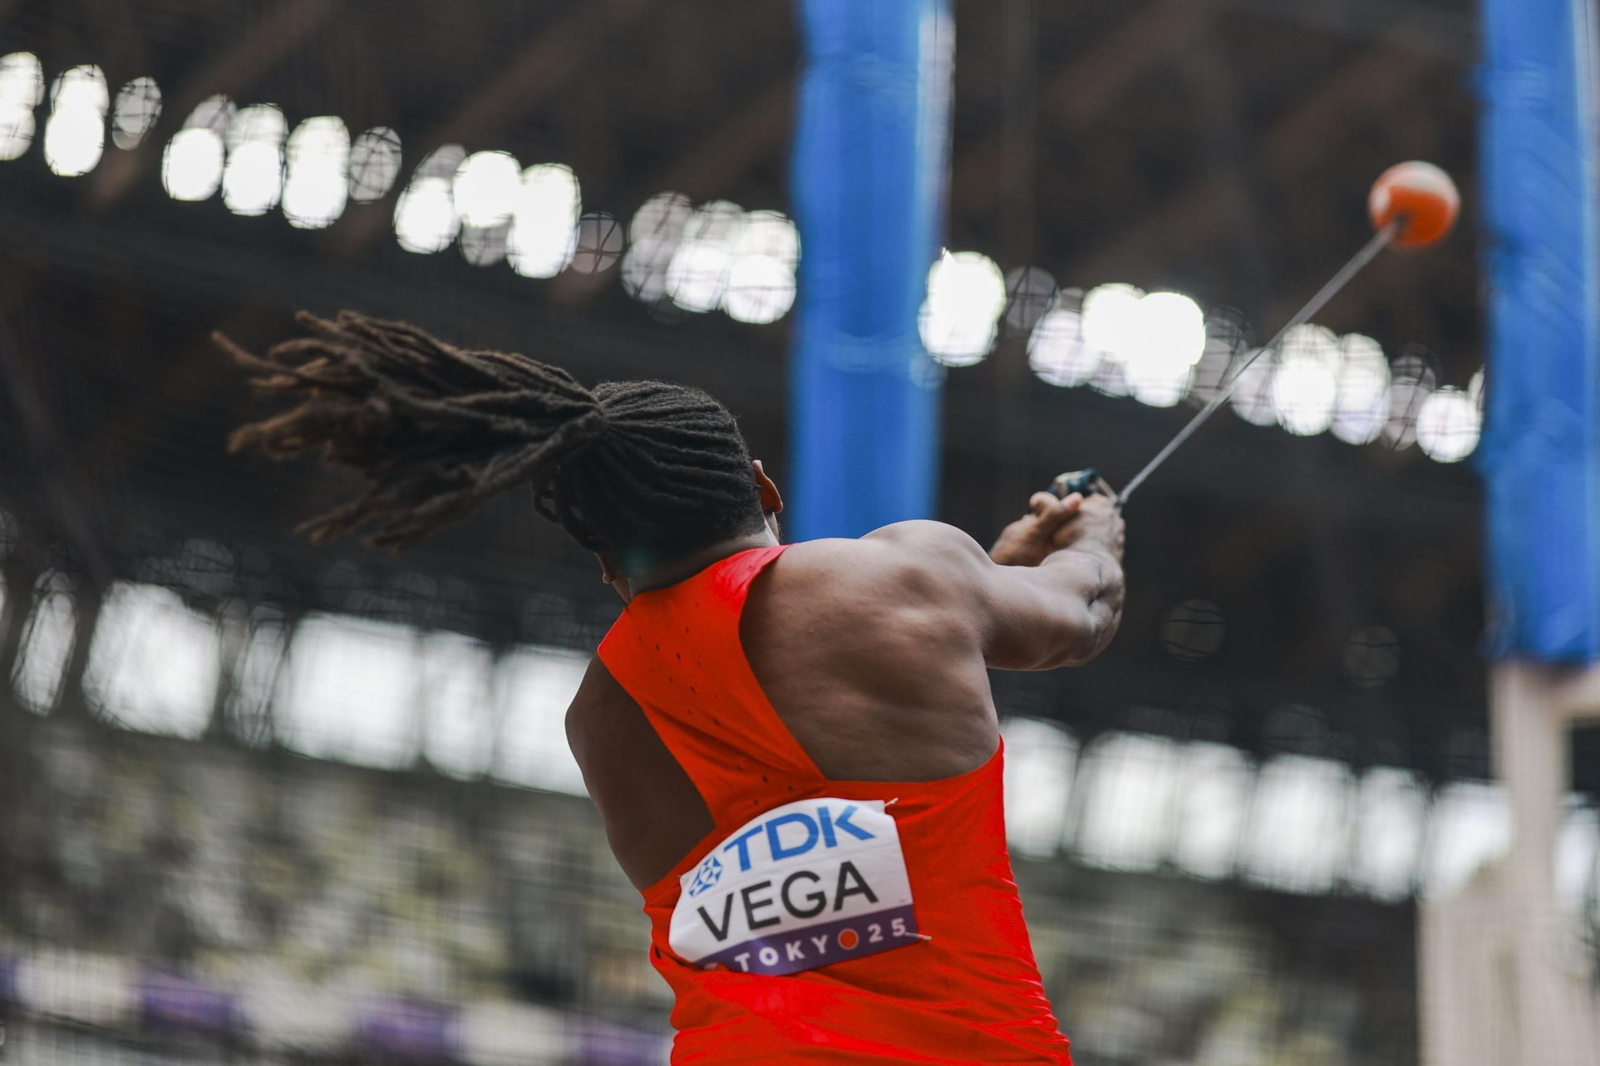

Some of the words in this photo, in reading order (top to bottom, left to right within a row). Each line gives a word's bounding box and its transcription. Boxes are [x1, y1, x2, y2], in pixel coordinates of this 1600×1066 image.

[723, 805, 876, 872] TDK
[697, 861, 879, 942] VEGA
[867, 918, 906, 943] 25
